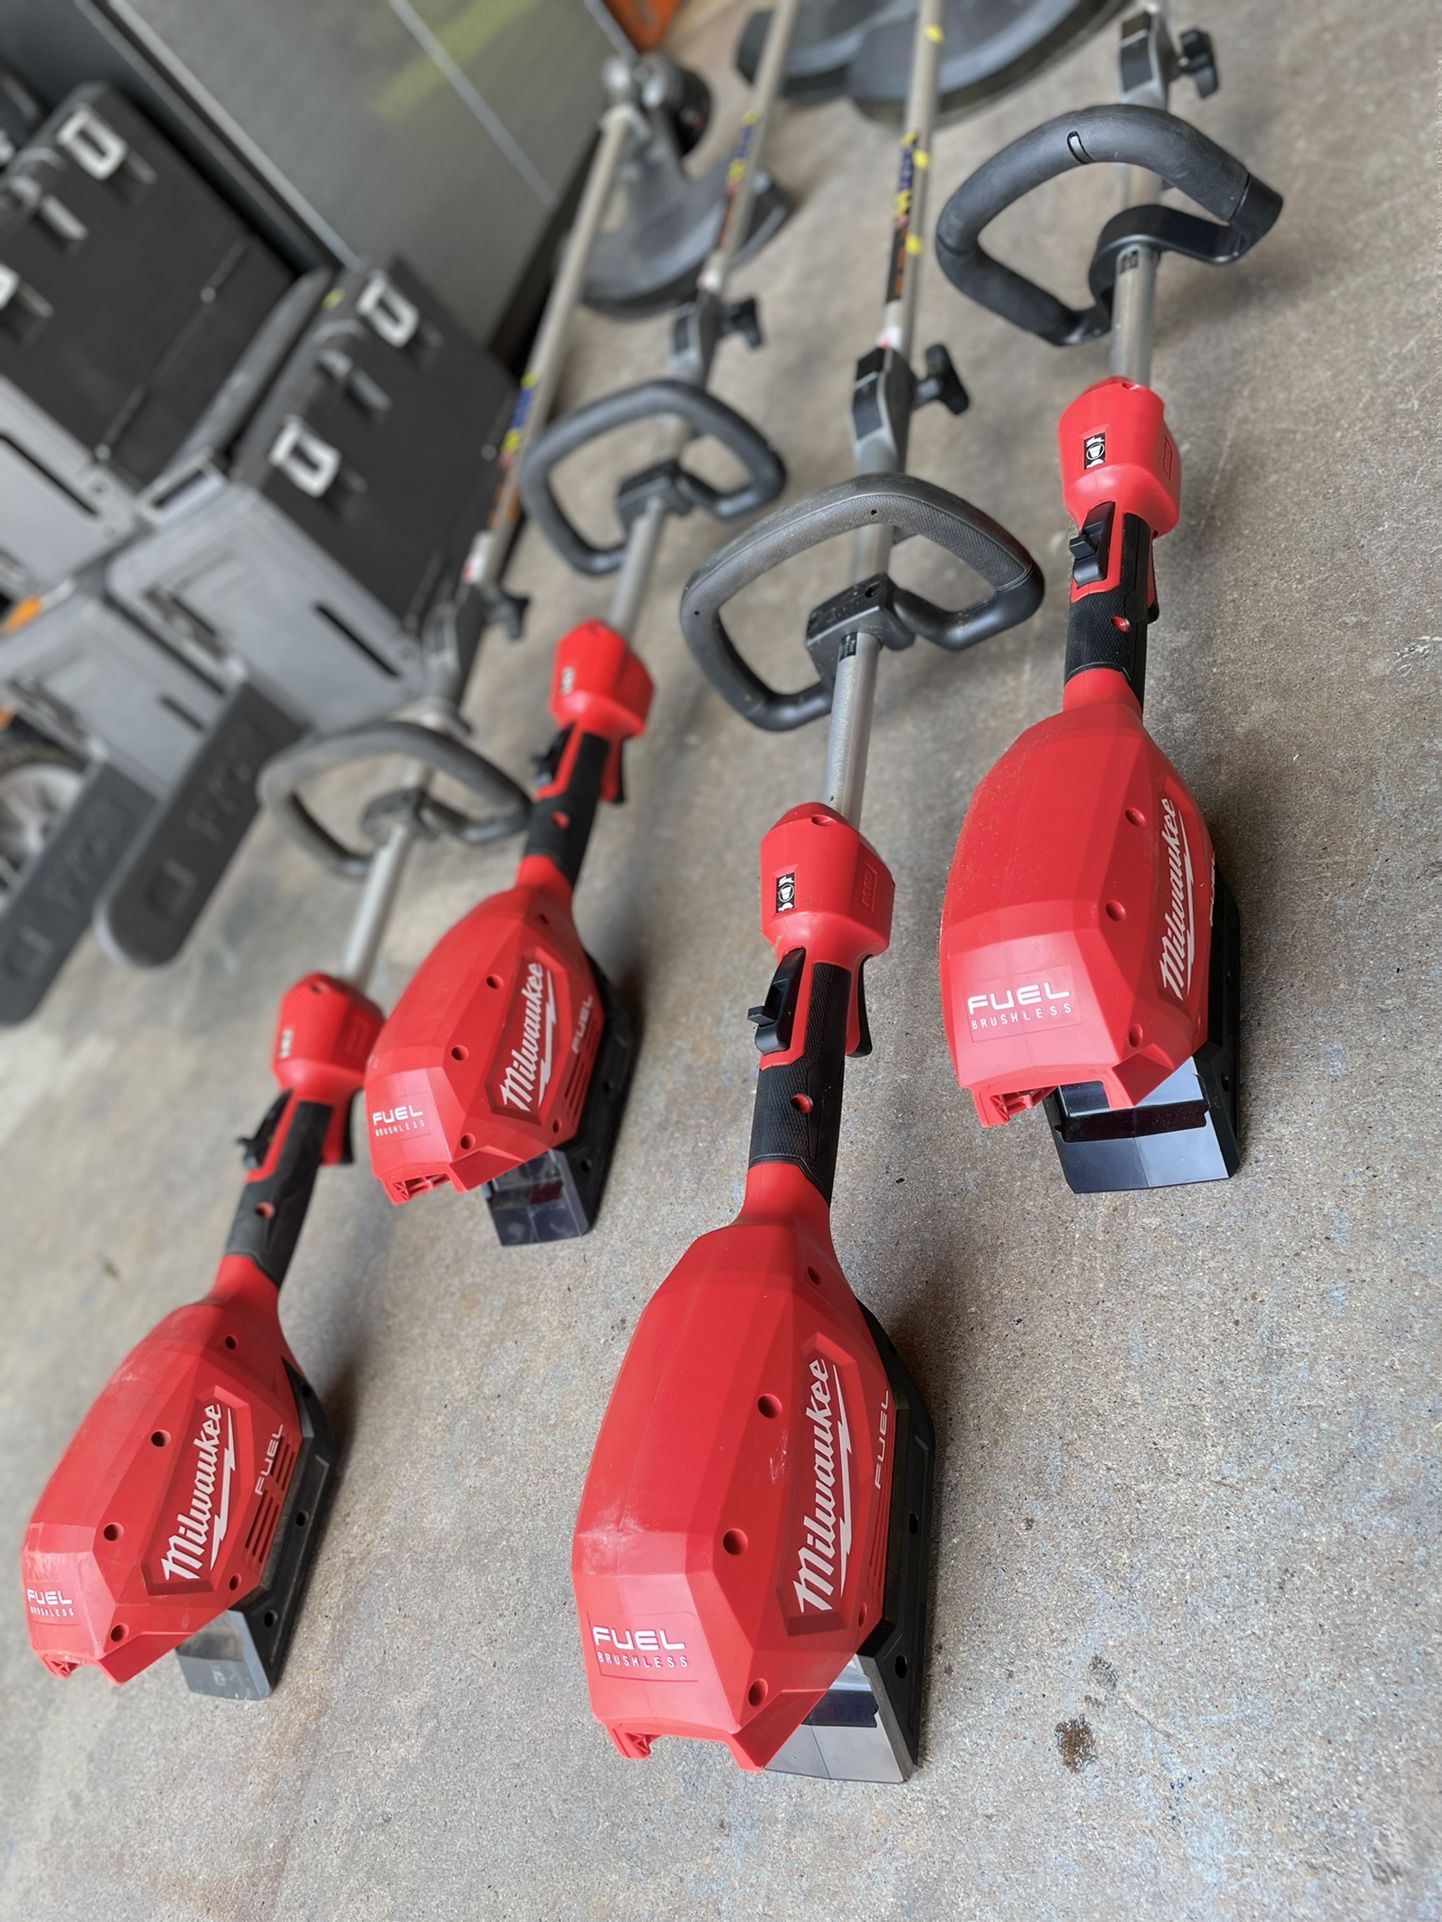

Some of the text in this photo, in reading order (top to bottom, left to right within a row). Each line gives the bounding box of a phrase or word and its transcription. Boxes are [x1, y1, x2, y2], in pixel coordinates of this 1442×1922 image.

[1158, 797, 1186, 1002] Milwaukee
[571, 995, 593, 1055] FUEL
[966, 981, 1072, 1016] FUEL
[970, 1002, 1073, 1031] BRUSHLESS
[499, 962, 546, 1111] Milwaukee
[372, 1105, 424, 1126] FUEL
[255, 1423, 285, 1496] FUEL
[874, 1390, 890, 1490] FUEL
[161, 1403, 223, 1581] Milwaukee
[793, 1358, 835, 1614] Milwaukee
[26, 1588, 73, 1605] FUEL
[593, 1626, 687, 1652] FUEL
[597, 1652, 689, 1669] BRUSHLESS
